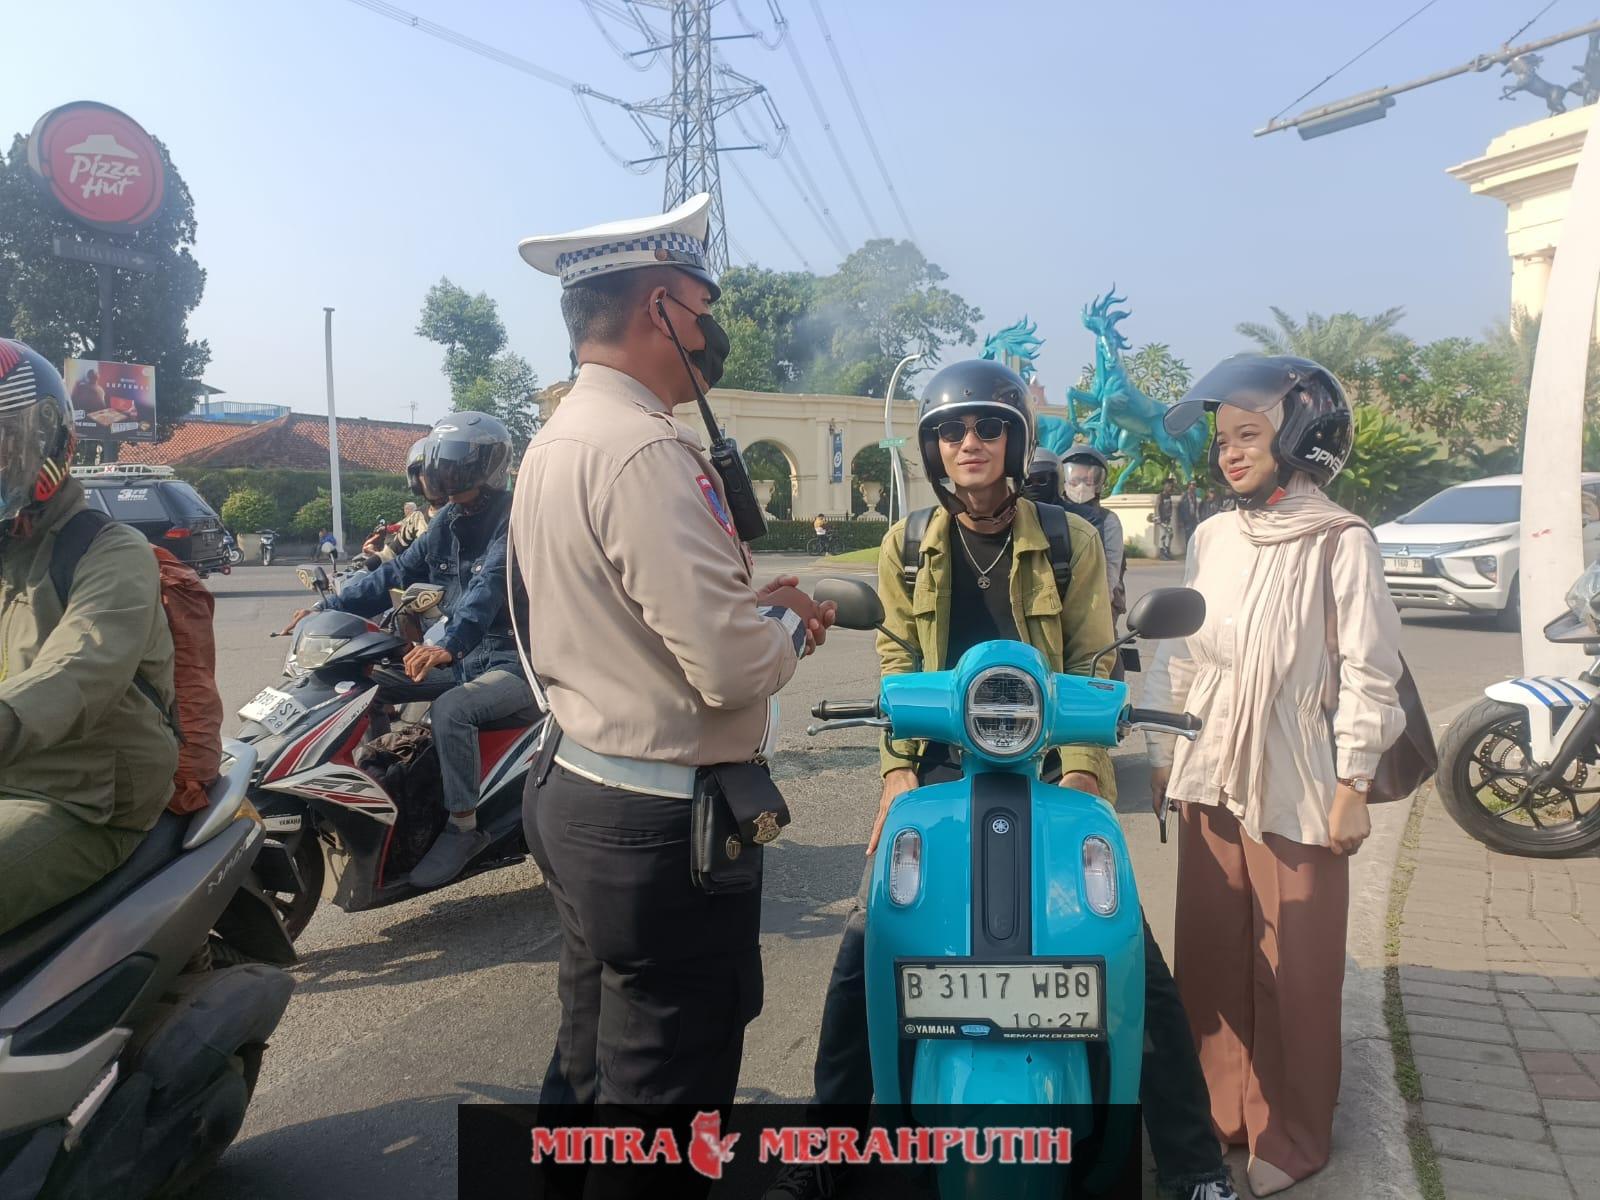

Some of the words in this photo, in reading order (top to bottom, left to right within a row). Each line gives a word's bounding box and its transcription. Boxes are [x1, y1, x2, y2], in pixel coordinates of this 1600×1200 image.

[69, 153, 142, 184] Pizza
[80, 177, 135, 199] Hut
[907, 973, 923, 999] B
[939, 973, 1011, 999] 3117
[916, 1024, 956, 1035] YAMAHA
